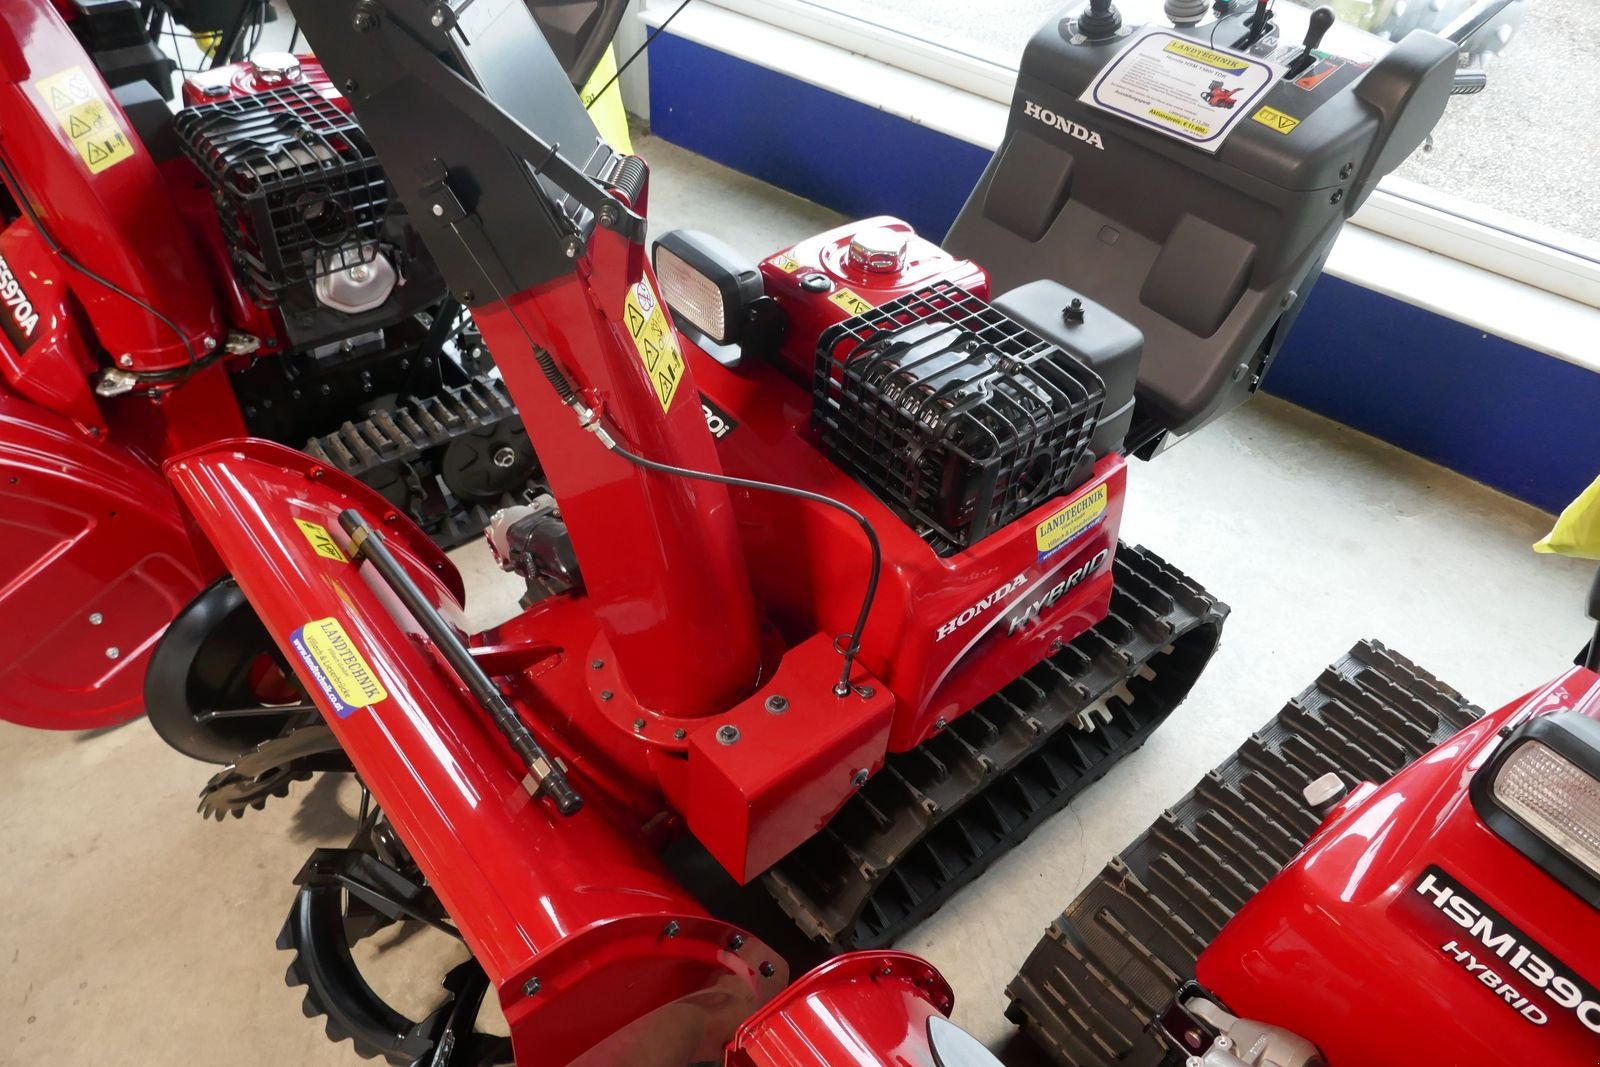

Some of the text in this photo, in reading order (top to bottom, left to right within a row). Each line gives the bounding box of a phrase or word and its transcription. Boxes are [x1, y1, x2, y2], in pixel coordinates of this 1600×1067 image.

[1171, 41, 1239, 68] LANDTECHNIK
[1024, 100, 1104, 150] HONDA
[1040, 488, 1104, 537] LANDTECHNIK
[936, 573, 1029, 642] HONDA
[1007, 548, 1110, 636] HYBRID
[293, 638, 344, 712] www.landtechnik.co.at
[307, 635, 323, 656] Villach
[321, 622, 380, 699] LANDTECHNIK
[1442, 941, 1548, 1025] HYBRID
